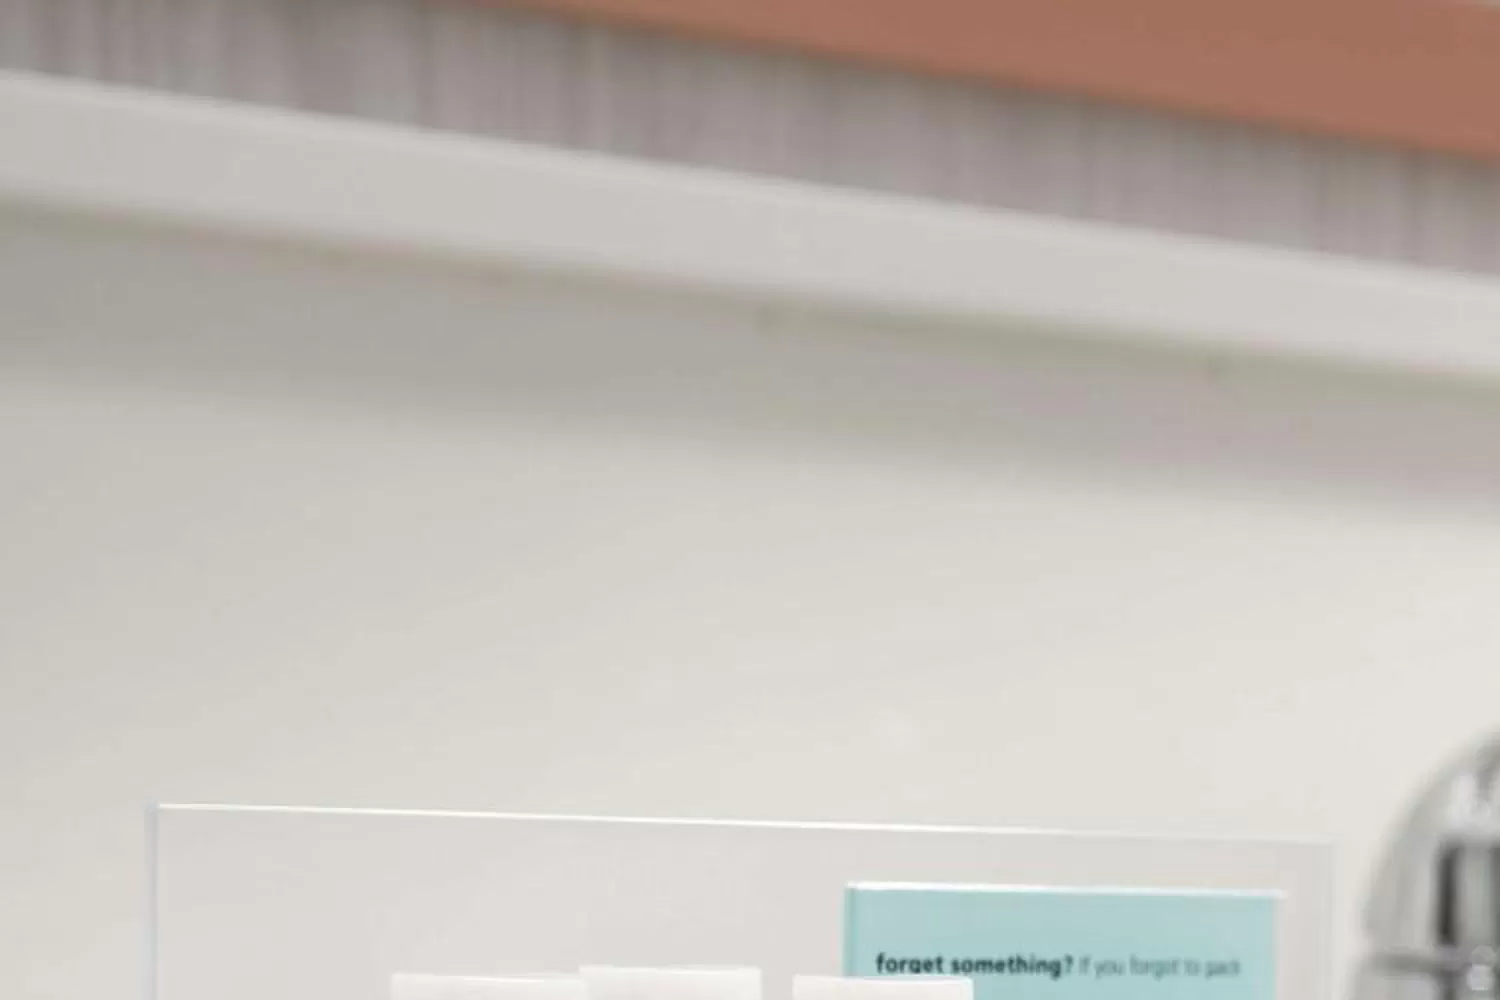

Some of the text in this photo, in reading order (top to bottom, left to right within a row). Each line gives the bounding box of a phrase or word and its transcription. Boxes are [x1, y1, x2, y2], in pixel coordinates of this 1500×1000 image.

[875, 952, 944, 976] forget
[950, 953, 1073, 980] something?
[1094, 959, 1122, 980] you
[1128, 955, 1178, 981] forgot
